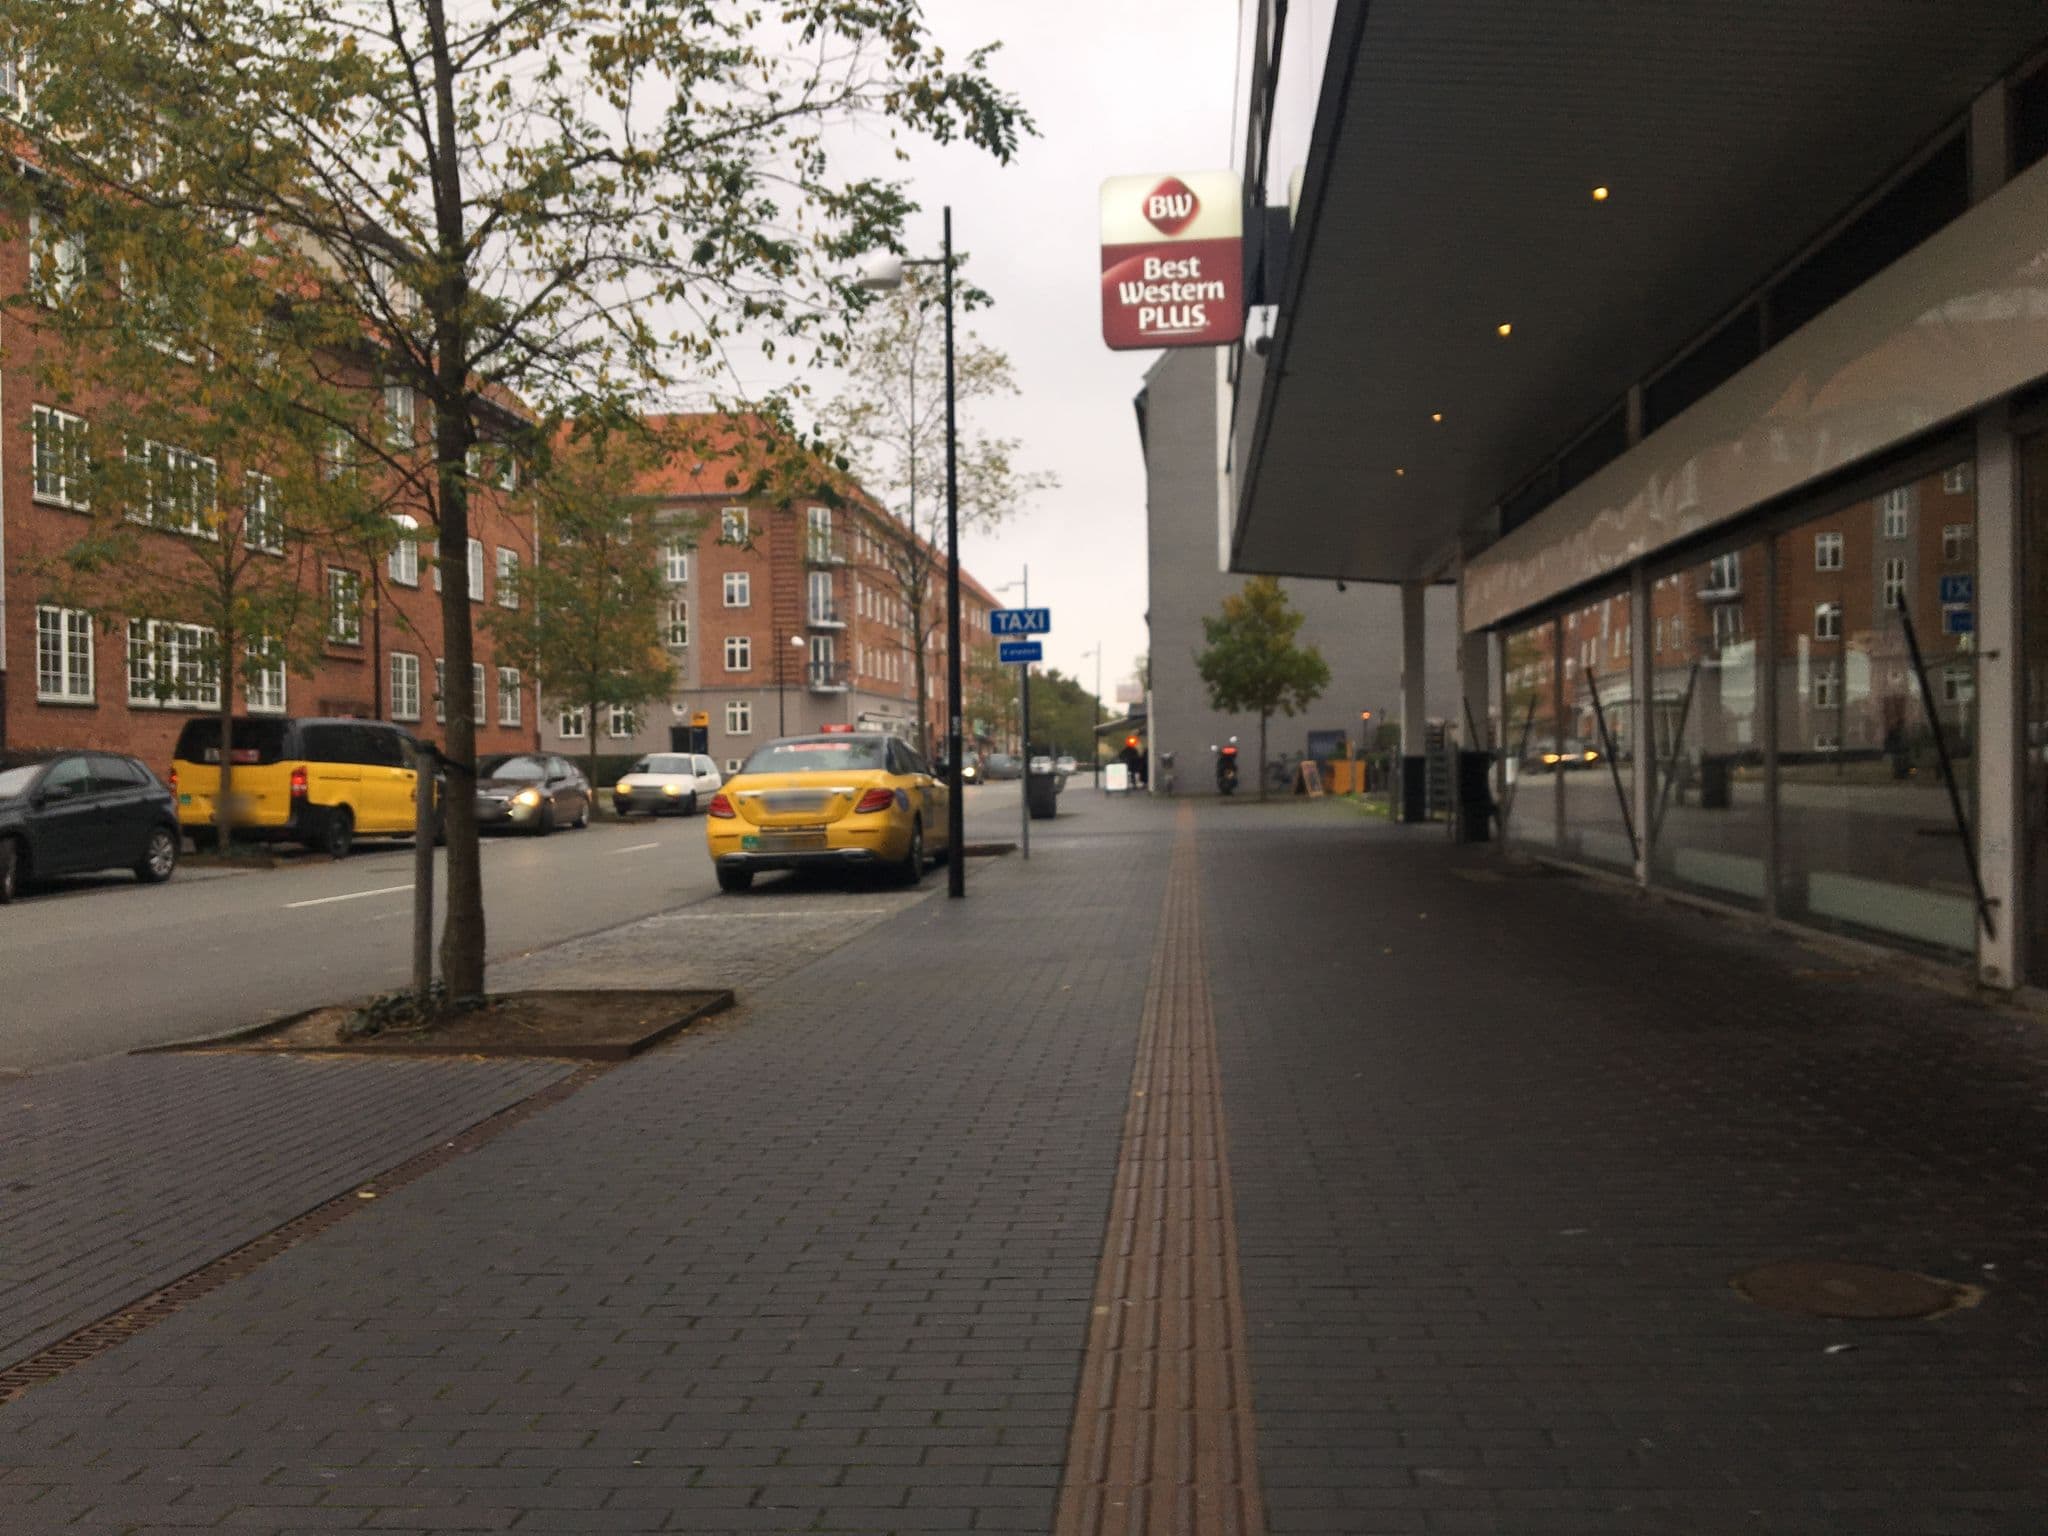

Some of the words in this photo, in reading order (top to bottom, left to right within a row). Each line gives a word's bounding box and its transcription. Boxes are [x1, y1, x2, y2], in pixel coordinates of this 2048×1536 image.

[1149, 194, 1193, 219] BW
[1144, 256, 1201, 280] Best
[1118, 280, 1225, 305] Western
[1138, 304, 1206, 329] PLUS
[996, 611, 1045, 631] TAXI
